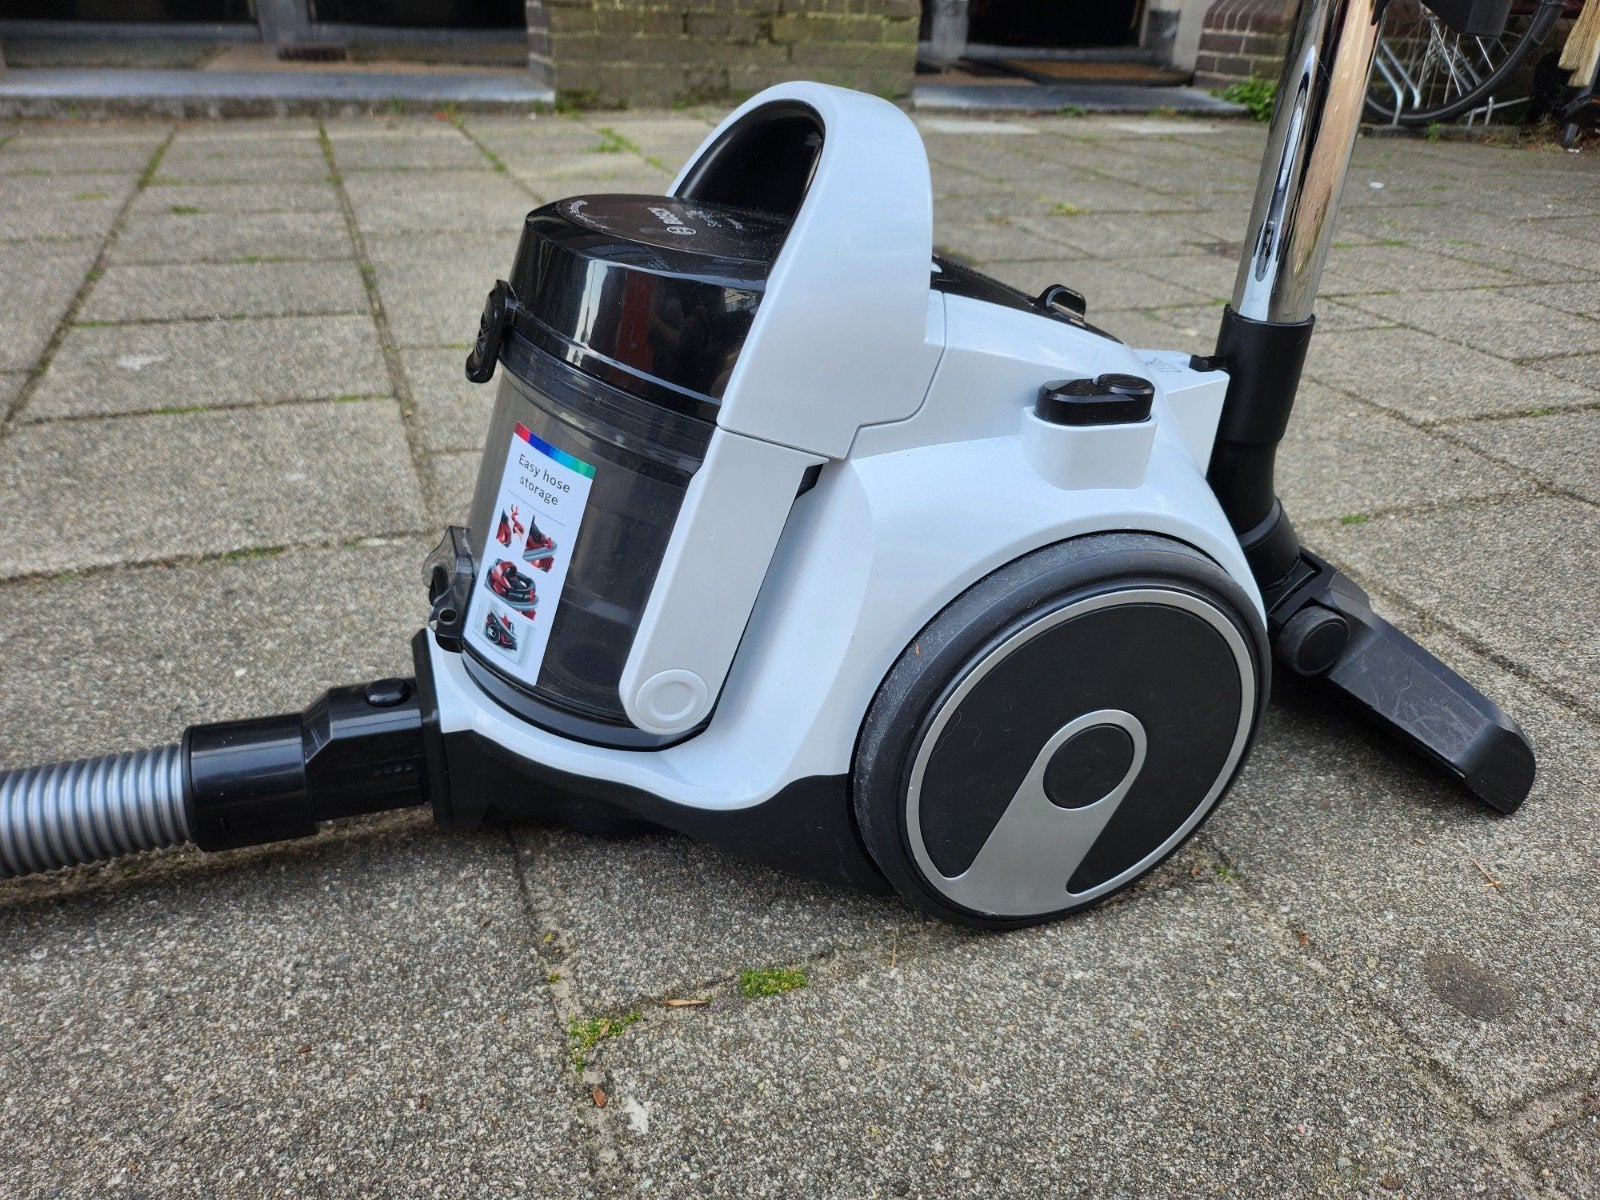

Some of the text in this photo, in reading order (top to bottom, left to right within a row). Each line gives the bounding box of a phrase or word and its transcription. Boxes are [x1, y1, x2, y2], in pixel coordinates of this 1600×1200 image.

[518, 453, 571, 493] Easy hose
[519, 476, 559, 506] storage
